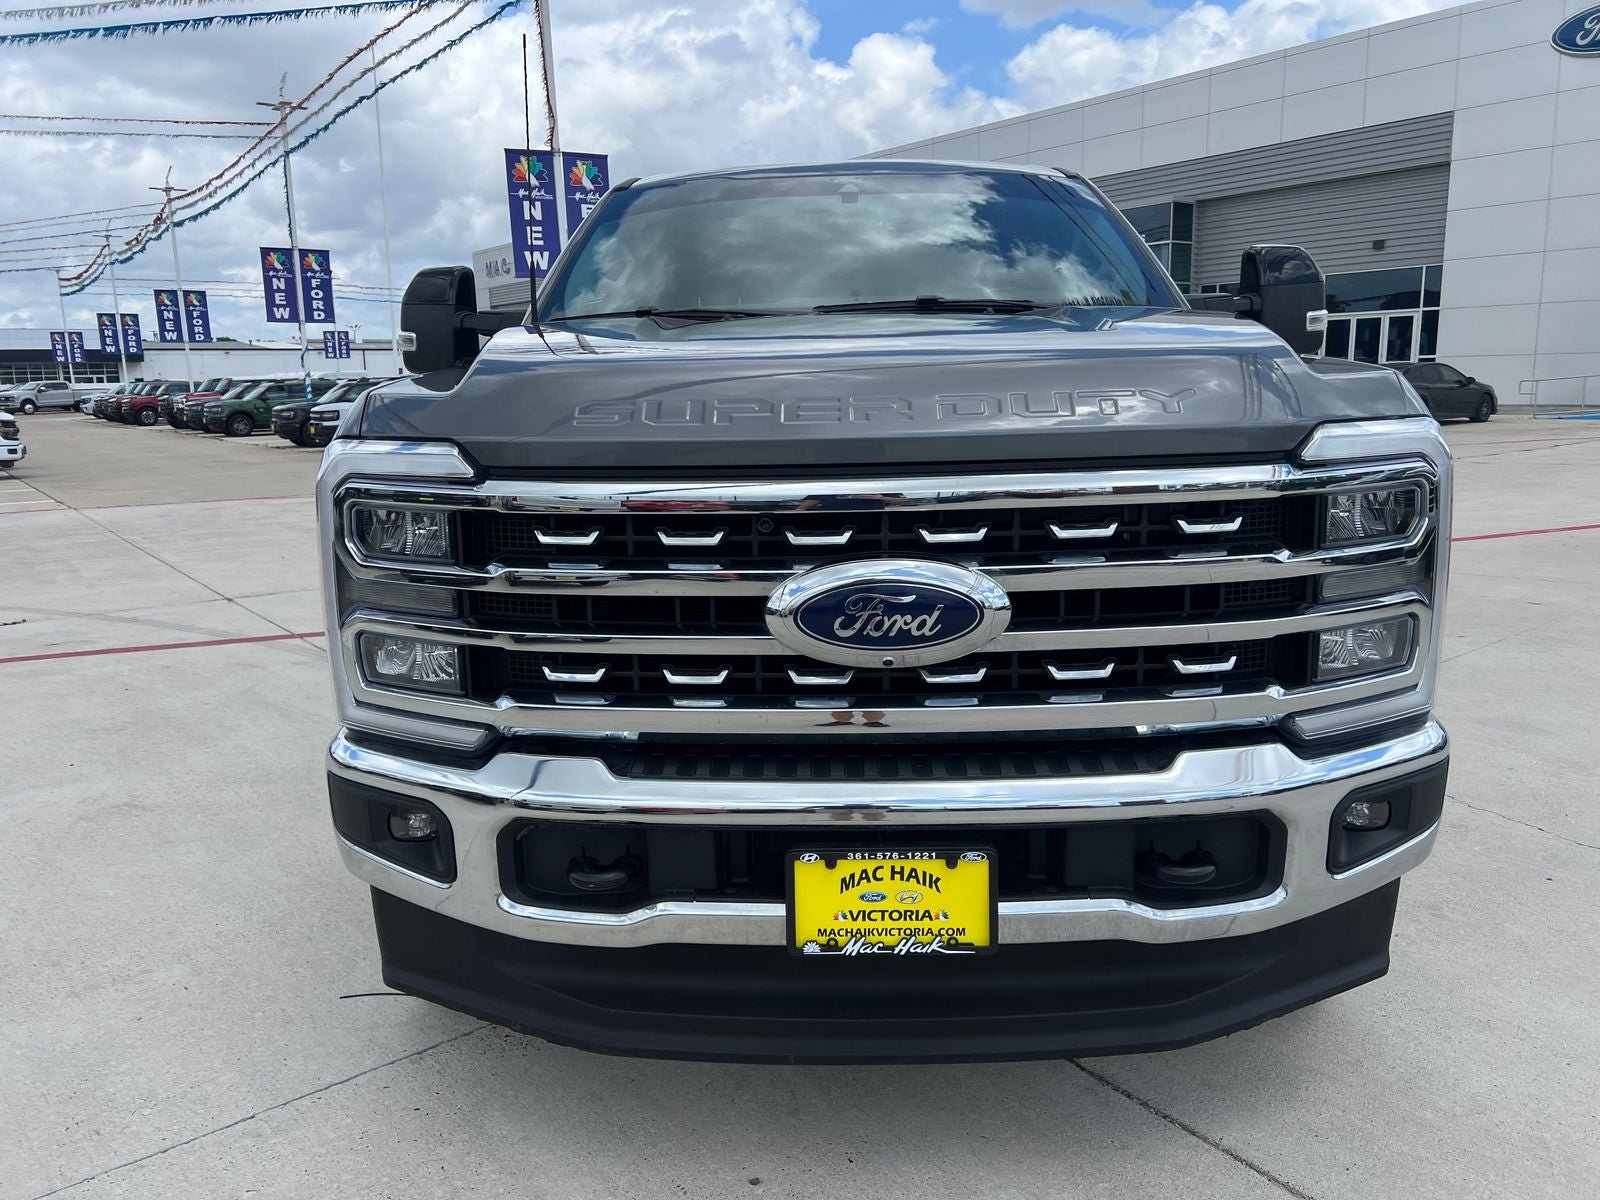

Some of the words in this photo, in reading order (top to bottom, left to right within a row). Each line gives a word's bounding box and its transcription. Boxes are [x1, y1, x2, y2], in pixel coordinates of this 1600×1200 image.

[523, 200, 549, 270] NEW
[272, 278, 290, 319] NEW
[310, 279, 326, 320] FORD
[163, 310, 178, 340] NEW
[192, 311, 205, 341] FORD
[55, 343, 65, 362] NEW
[104, 329, 116, 353] NEW
[127, 329, 138, 353] FORD
[572, 396, 912, 426] SUPER
[936, 388, 1198, 421] DUTY
[833, 593, 945, 638] Ford
[847, 852, 937, 860] 361-576-1221
[965, 853, 982, 861] Ford
[839, 865, 885, 894] MAC
[889, 865, 942, 894] HAIK
[863, 893, 882, 901] Ford
[848, 909, 934, 922] VICTORIA
[817, 927, 966, 937] MACHAIKVICTORIA.COM
[840, 936, 888, 956] Mac
[893, 936, 948, 956] Haik
